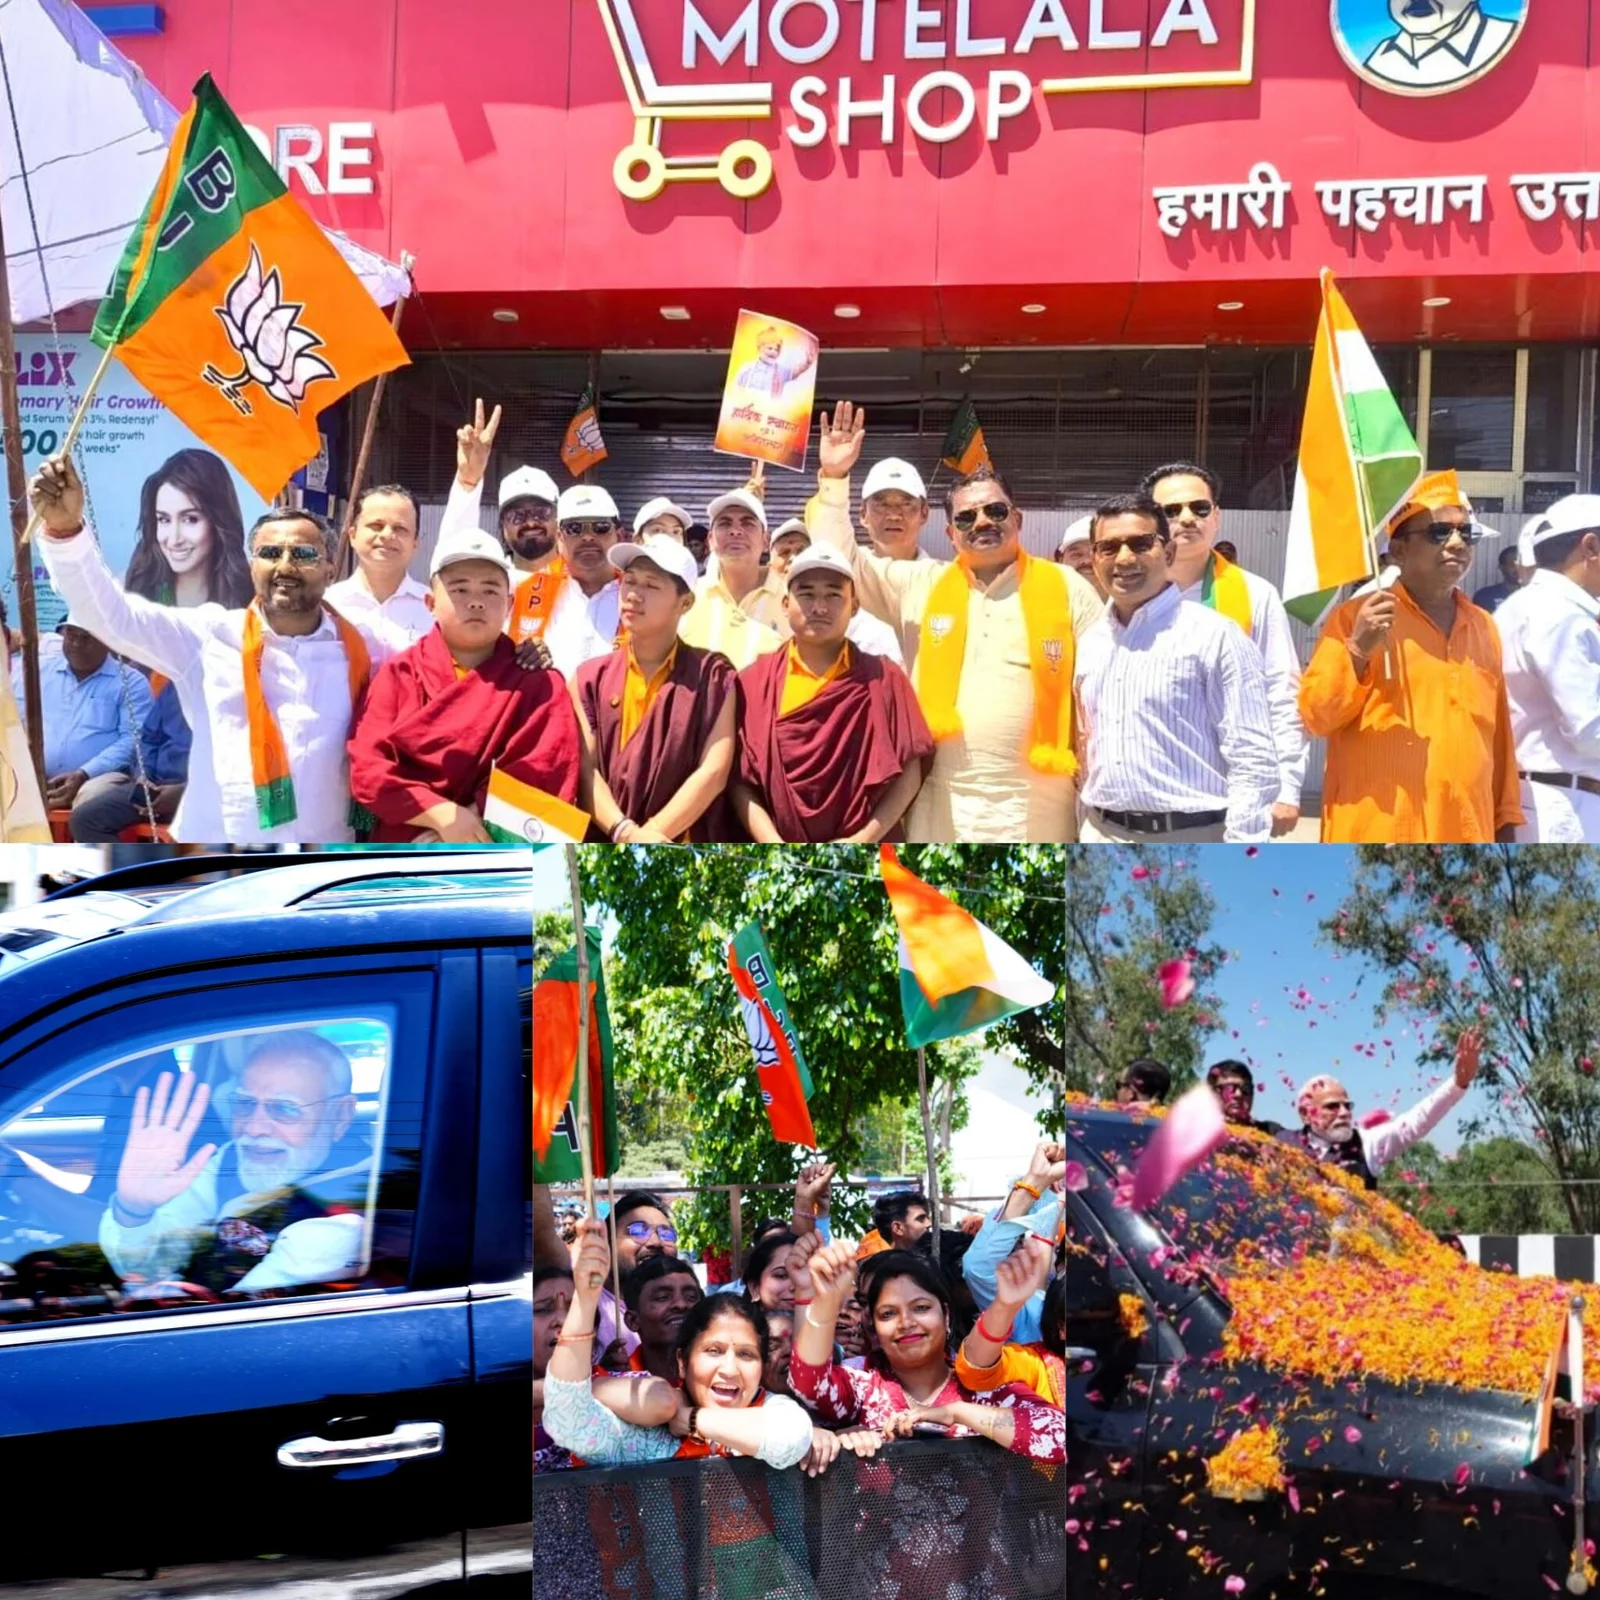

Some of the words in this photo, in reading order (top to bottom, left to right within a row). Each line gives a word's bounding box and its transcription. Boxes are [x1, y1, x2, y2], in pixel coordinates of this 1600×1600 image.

[682, 0, 1219, 69] MOTELALA
[786, 70, 1032, 147] SHOP
[241, 122, 375, 195] RE
[1153, 162, 1291, 238] हमारी
[1315, 175, 1488, 232] पहचान
[18, 396, 65, 411] mary
[0, 429, 58, 456] 00
[86, 430, 107, 440] hair
[108, 430, 145, 442] growth
